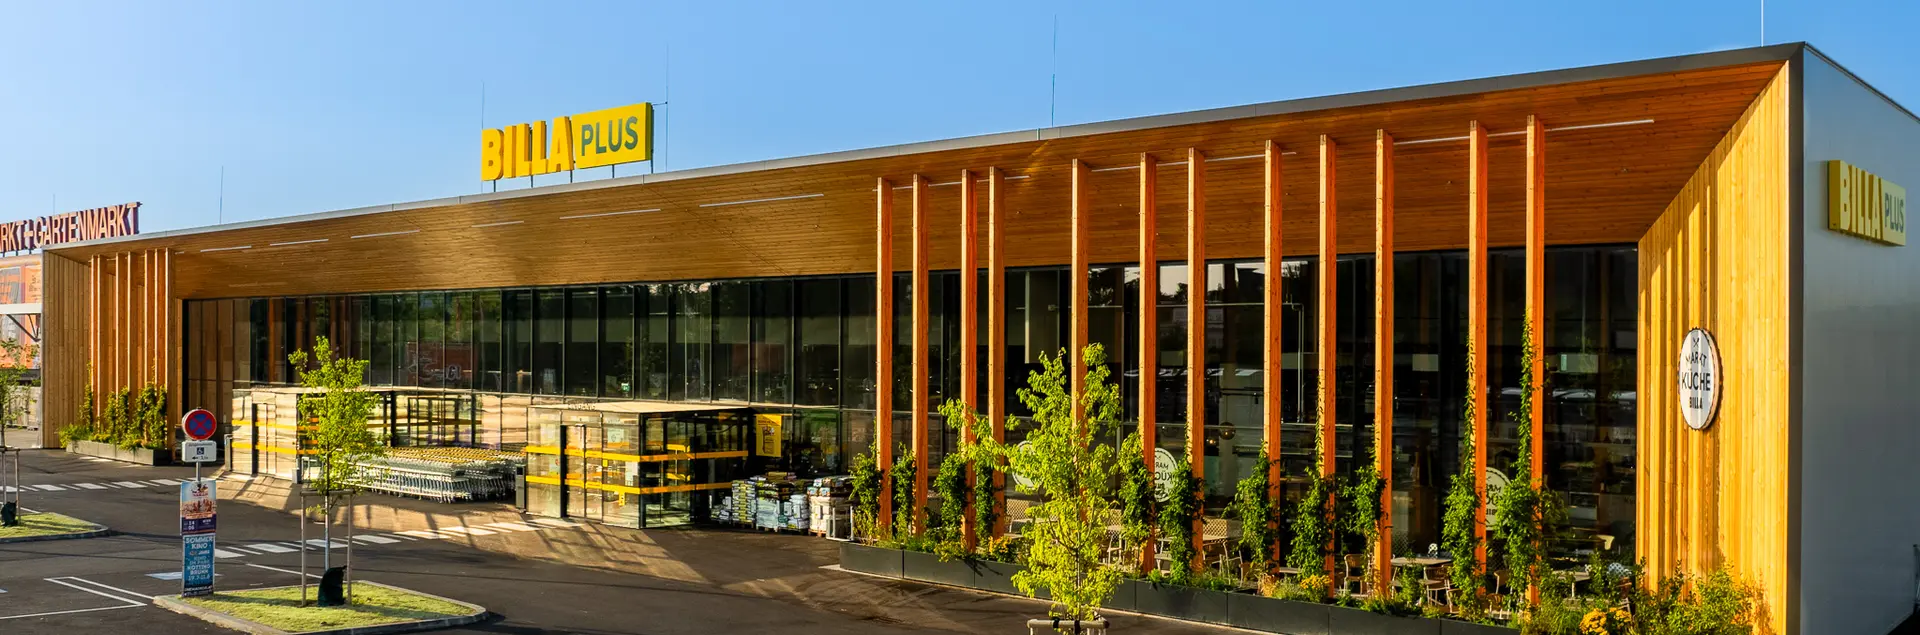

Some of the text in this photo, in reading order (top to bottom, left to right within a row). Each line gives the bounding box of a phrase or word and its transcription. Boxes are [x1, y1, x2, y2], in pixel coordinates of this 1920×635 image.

[481, 115, 639, 182] BILLA PLUS
[1835, 160, 1905, 240] BILLA PLUS
[0, 220, 27, 252] RKT
[35, 202, 140, 248] GARTENMARKT
[1684, 351, 1708, 367] MARKT
[1681, 368, 1711, 392] KÜCHE
[1689, 396, 1704, 410] BILLA
